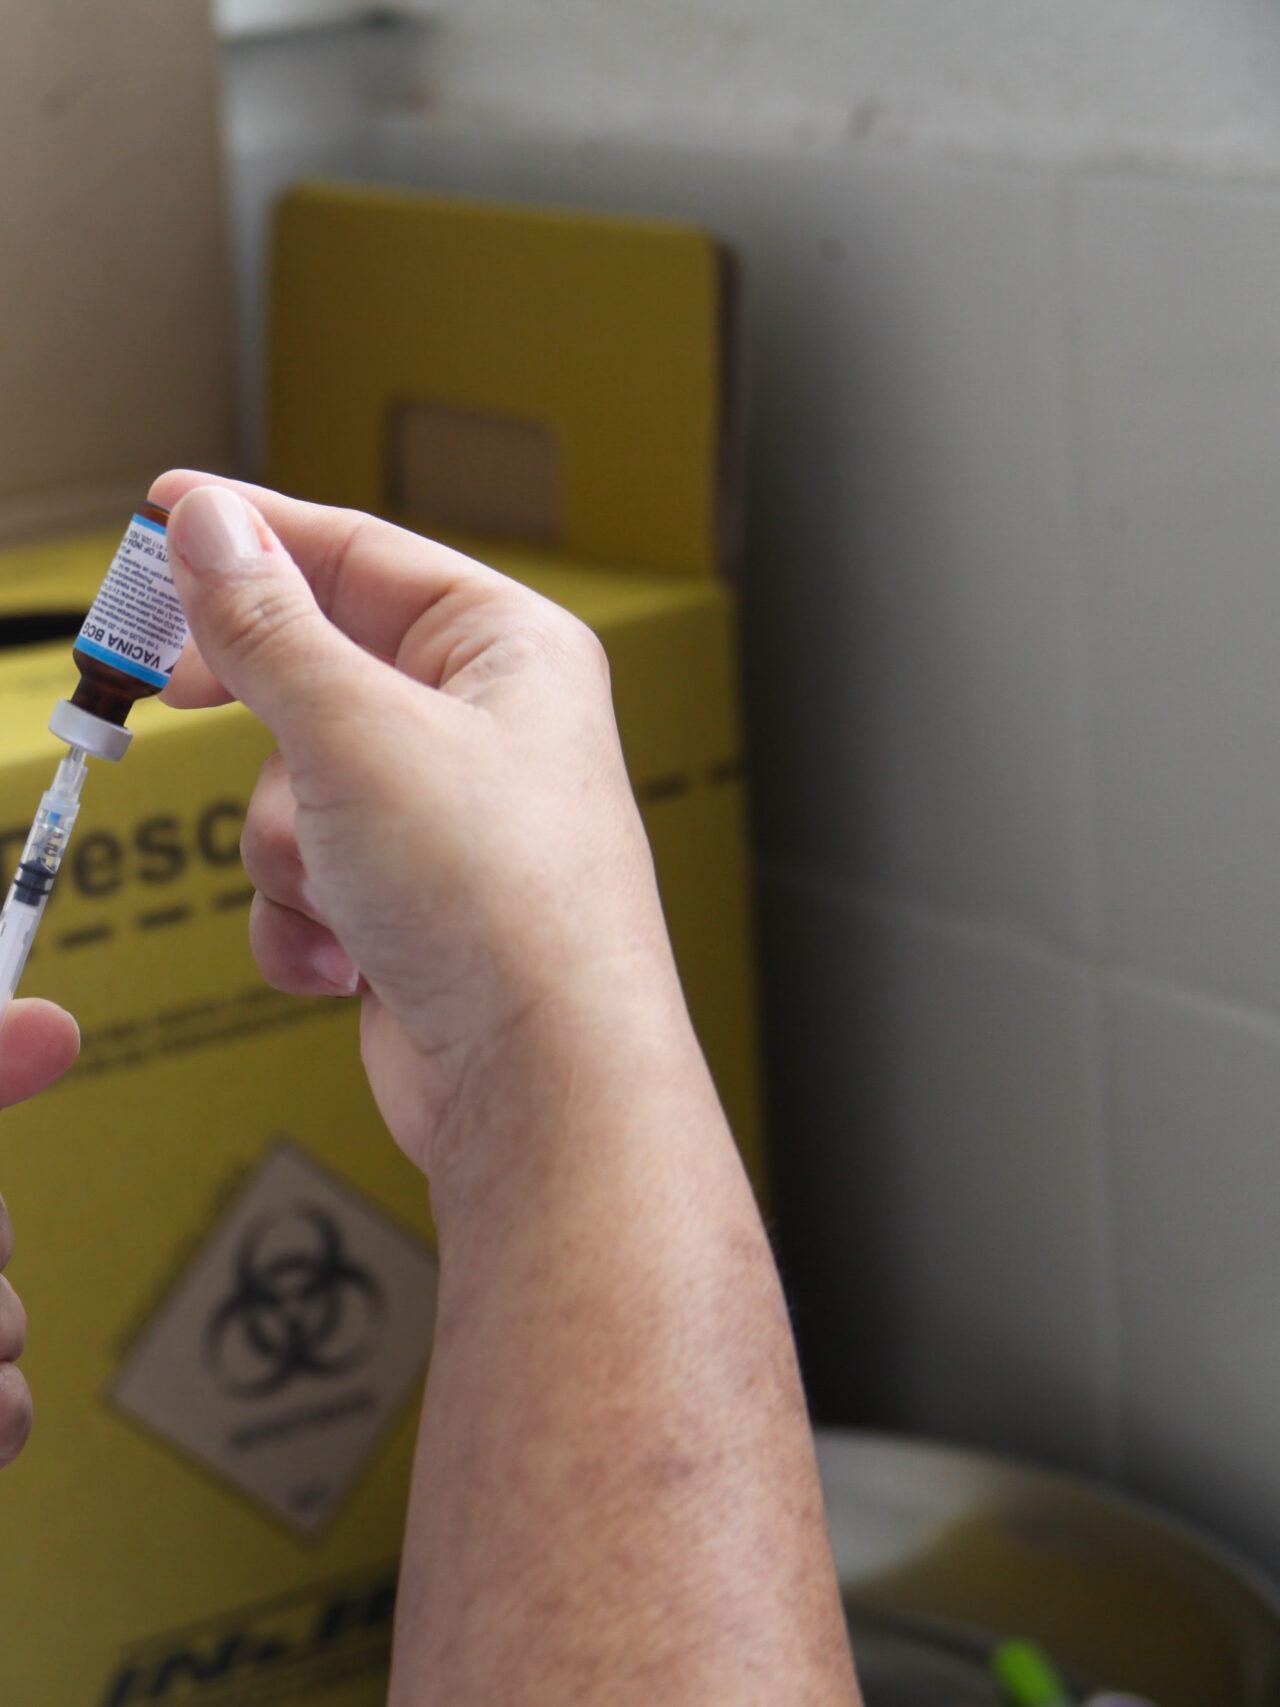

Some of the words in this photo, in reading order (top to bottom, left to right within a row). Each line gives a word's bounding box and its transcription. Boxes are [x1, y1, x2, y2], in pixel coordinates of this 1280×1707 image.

[143, 545, 155, 556] OF
[82, 622, 105, 641] BCG
[105, 633, 162, 668] VACINA
